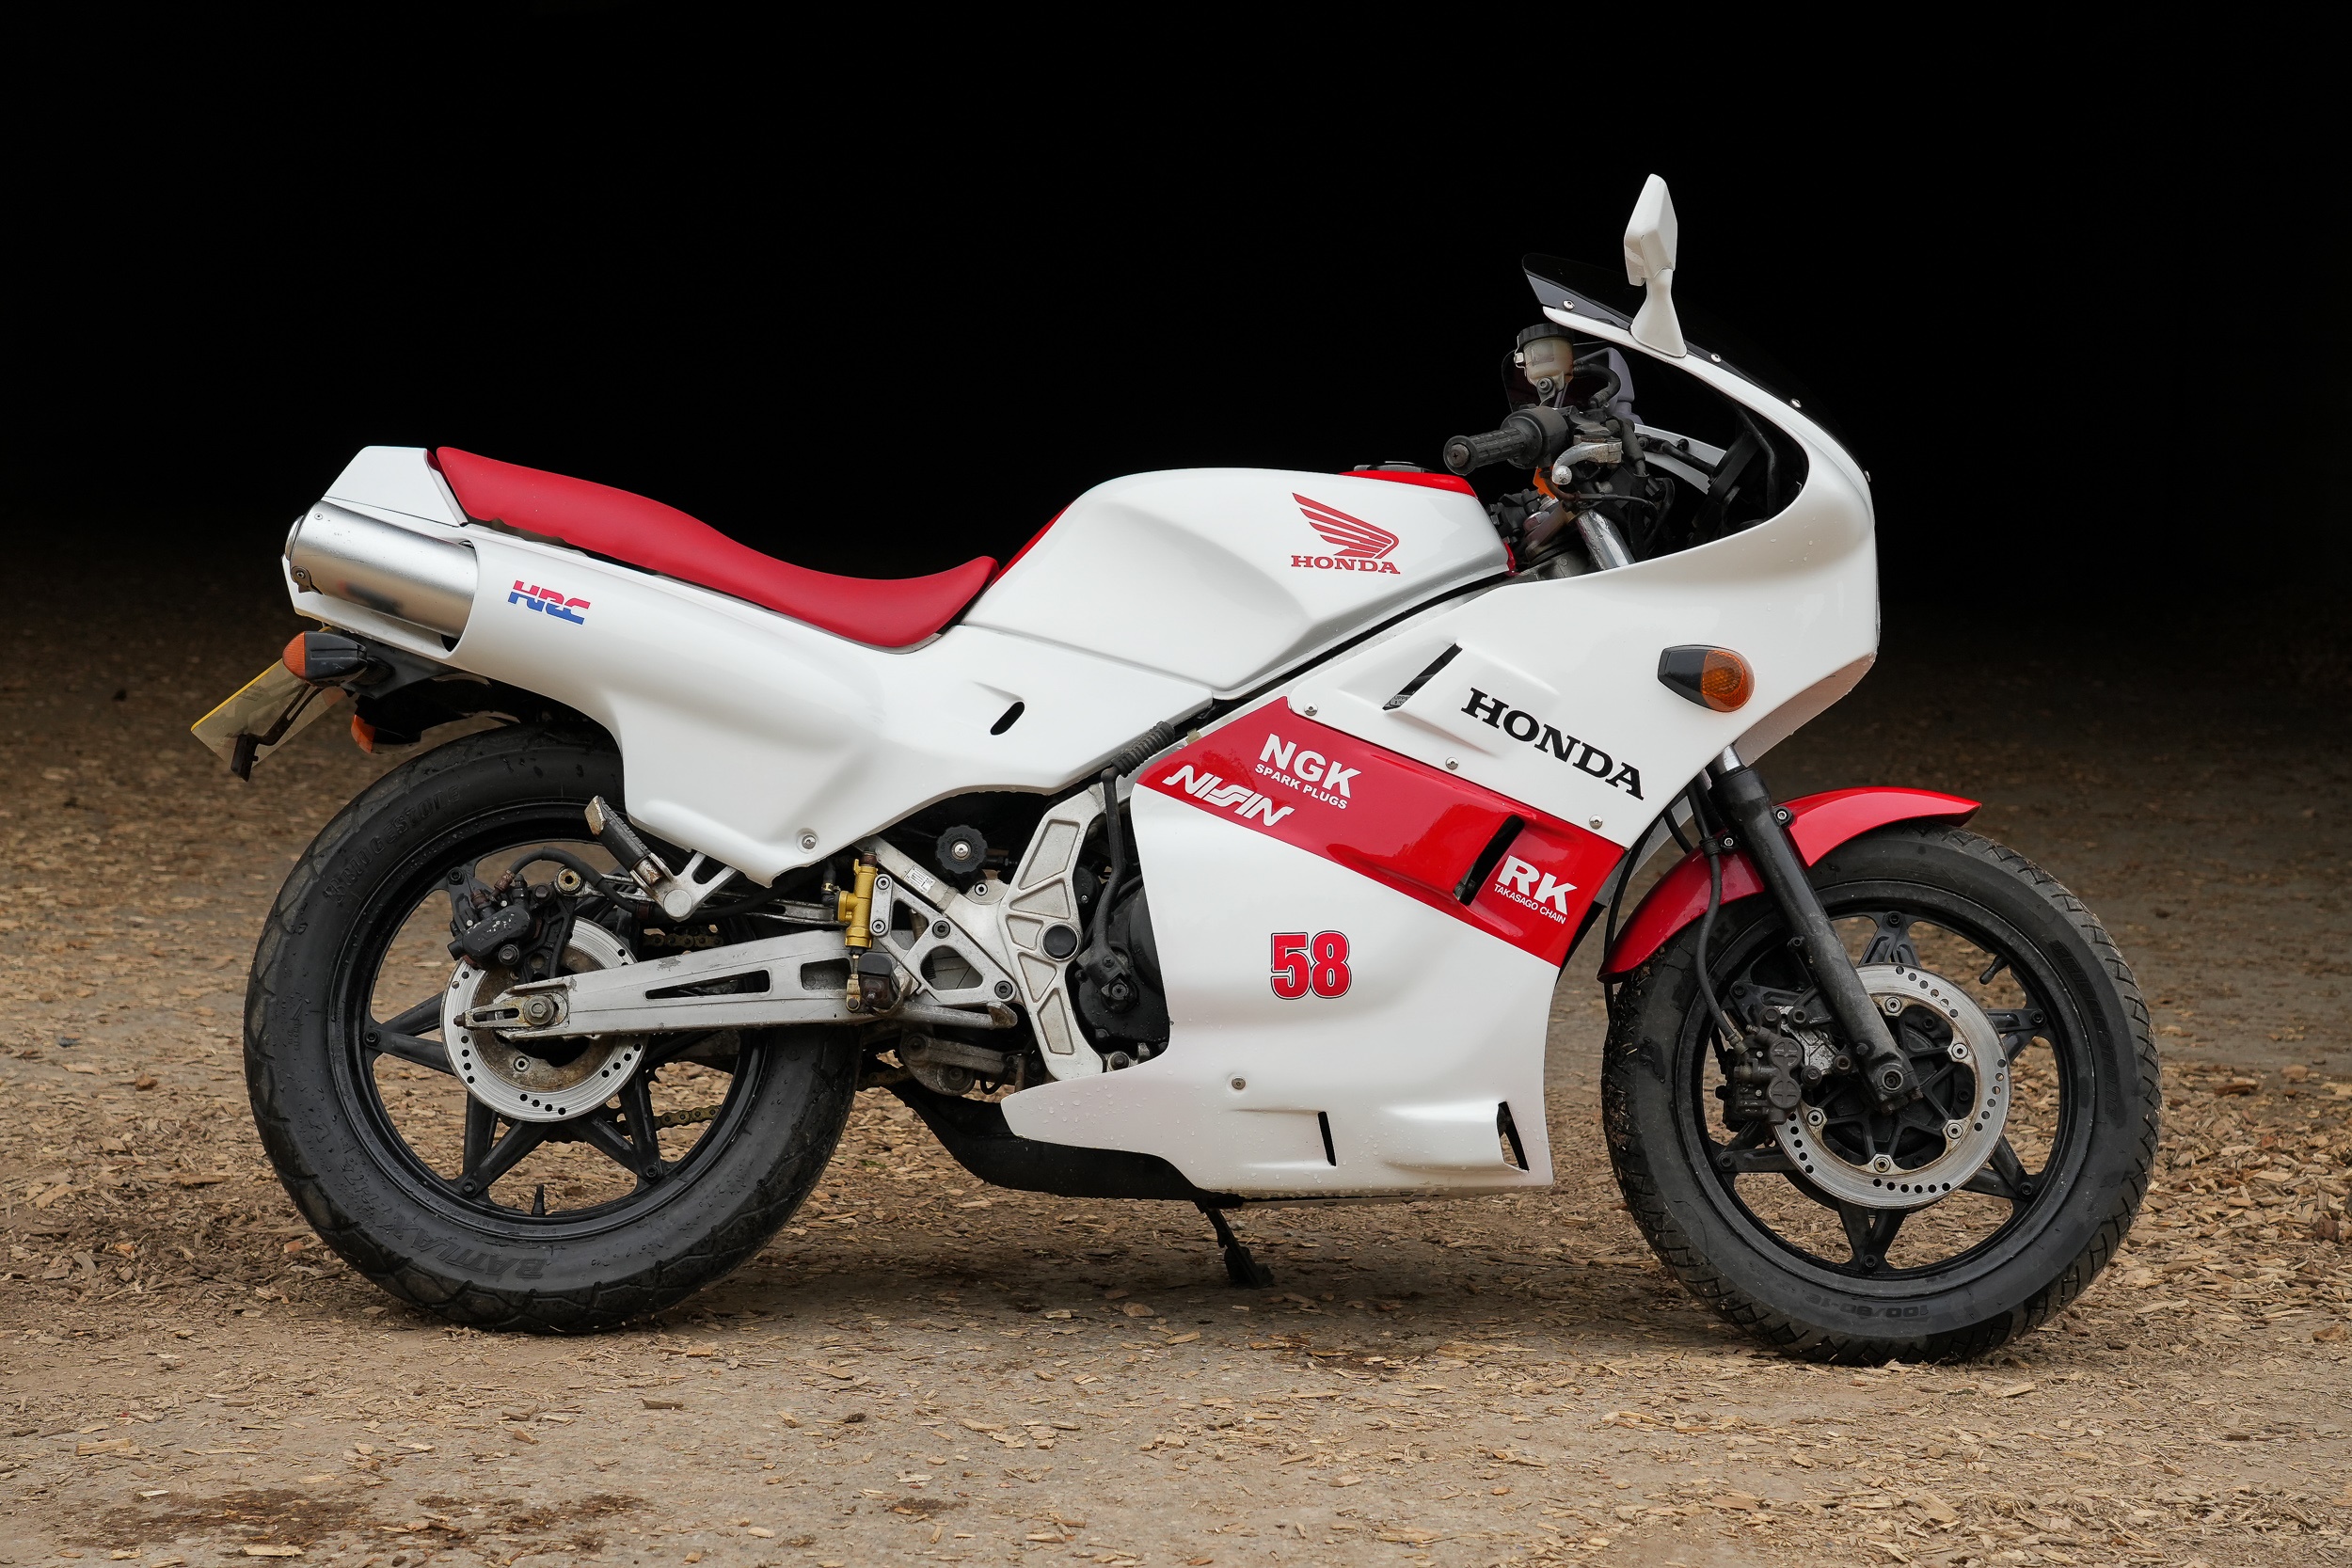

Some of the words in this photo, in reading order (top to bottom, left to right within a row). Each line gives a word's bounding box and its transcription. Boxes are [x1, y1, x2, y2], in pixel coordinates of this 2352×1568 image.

[1291, 555, 1401, 575] HONDA
[508, 579, 591, 626] HRC
[1259, 733, 1361, 799] NGK
[1461, 687, 1645, 801] HONDA
[1255, 763, 1301, 791] SPARK
[1302, 785, 1348, 810] PLUGS
[1494, 883, 1538, 911] TAKASAGO
[1539, 906, 1566, 925] CHAIN
[1497, 854, 1578, 915] RK
[1270, 930, 1353, 1000] 58
